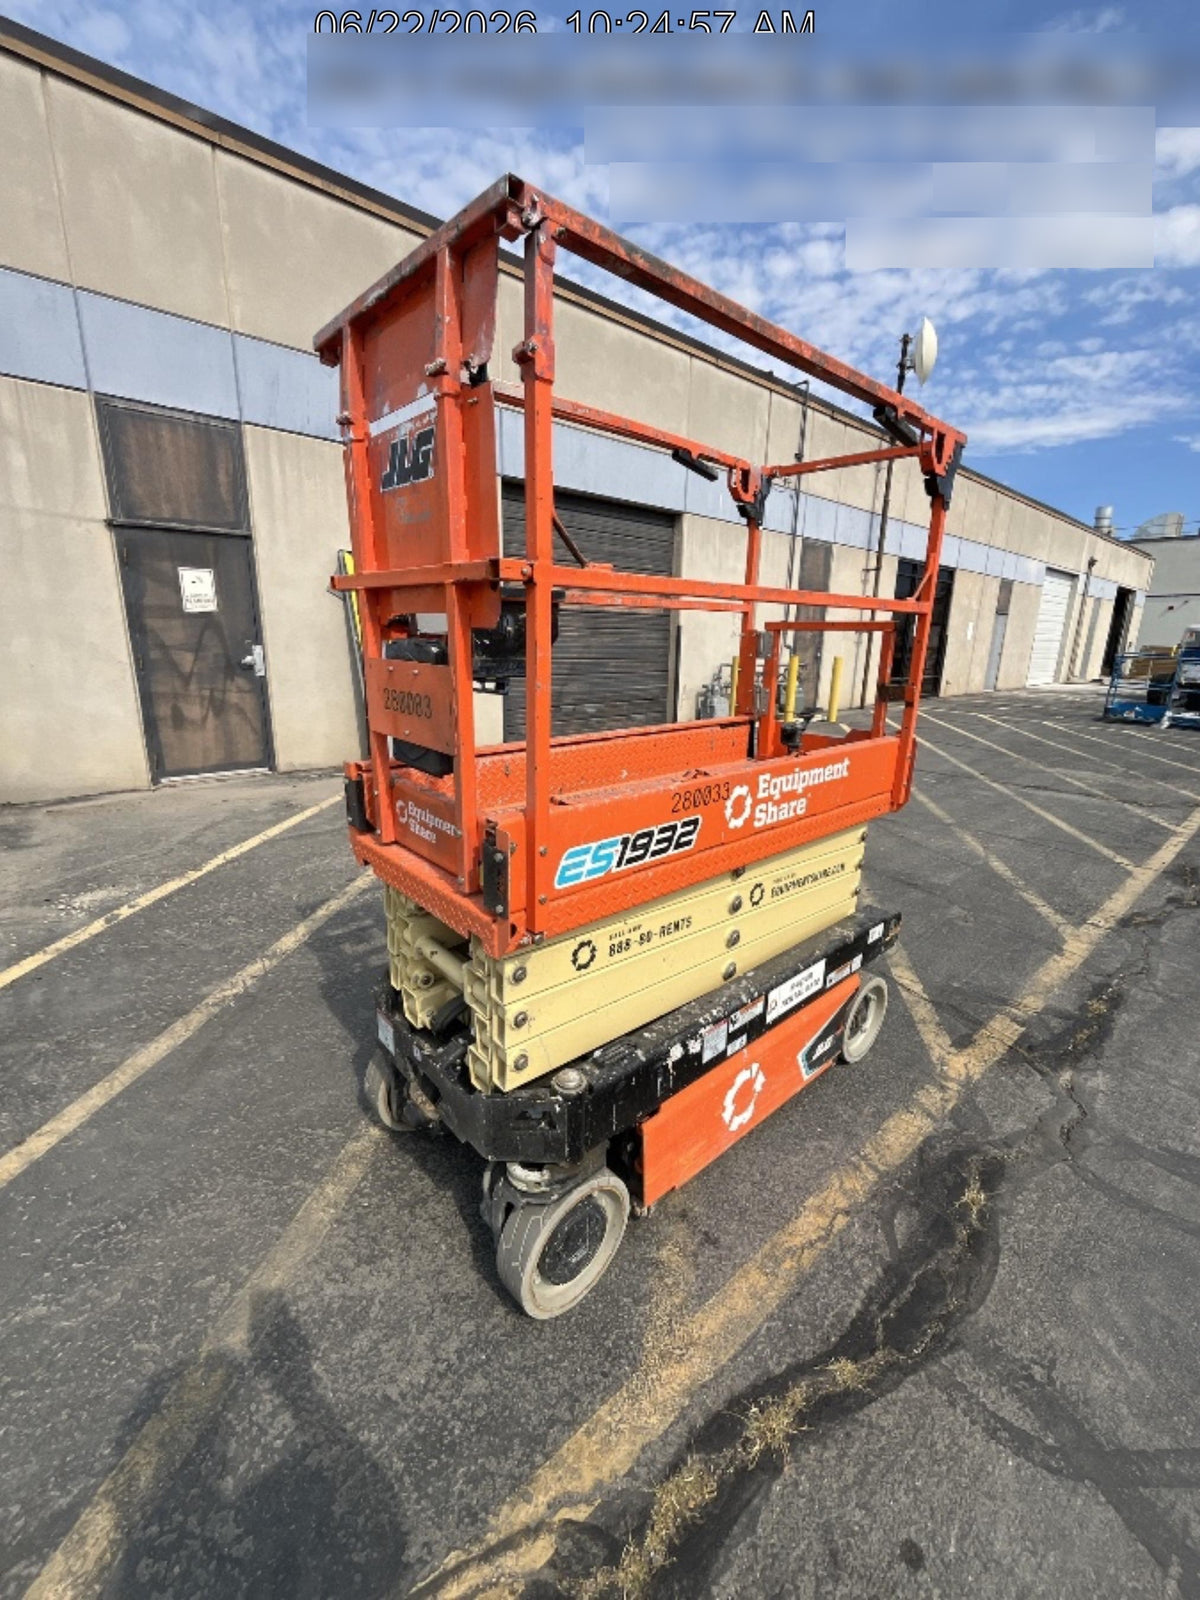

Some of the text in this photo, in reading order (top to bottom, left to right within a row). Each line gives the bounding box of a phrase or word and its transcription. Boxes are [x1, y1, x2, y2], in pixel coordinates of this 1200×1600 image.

[380, 425, 436, 493] JLG
[671, 781, 731, 814] 280033
[756, 757, 851, 801] Equipment
[753, 797, 808, 829] Share
[554, 814, 703, 889] ES1932
